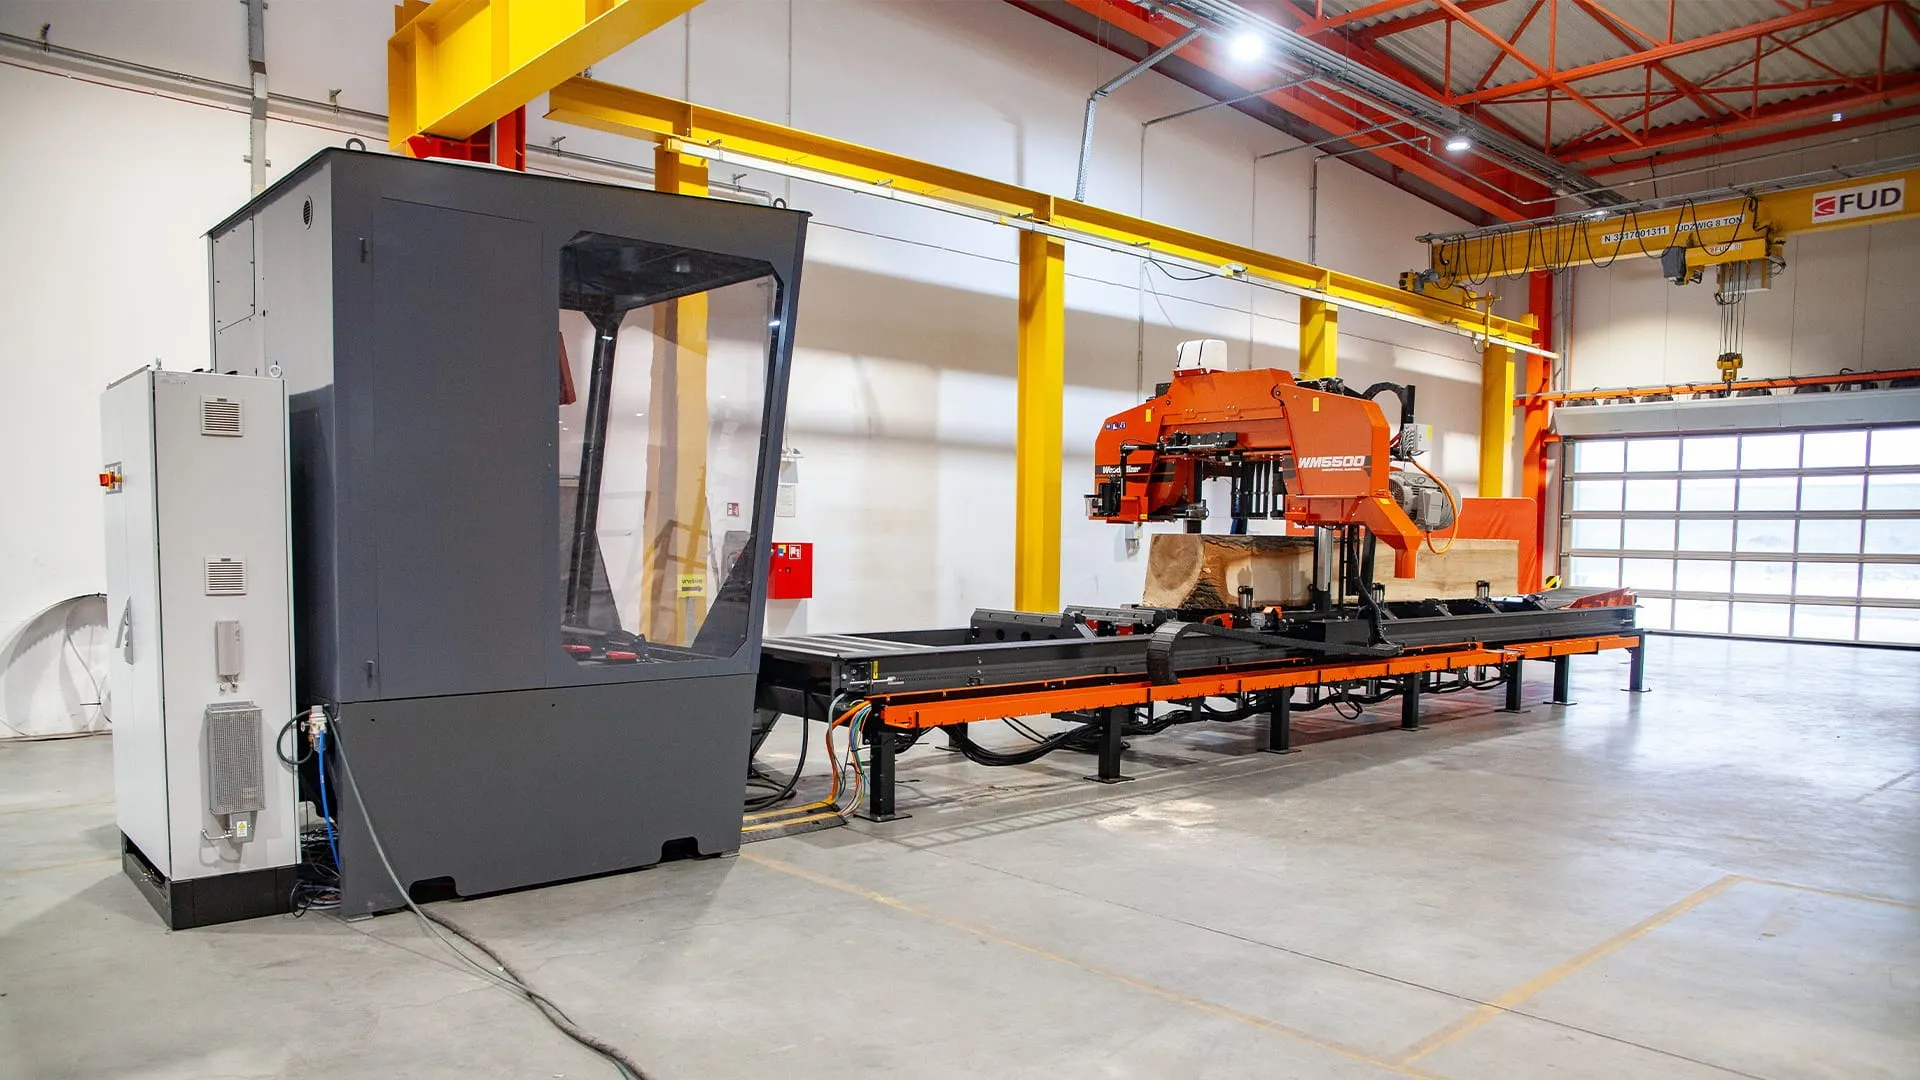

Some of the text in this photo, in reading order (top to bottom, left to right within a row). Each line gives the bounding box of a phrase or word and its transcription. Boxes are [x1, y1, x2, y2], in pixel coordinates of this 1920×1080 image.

[1839, 187, 1901, 213] FUD
[1715, 219, 1721, 227] 8
[1298, 455, 1366, 469] WM5500
